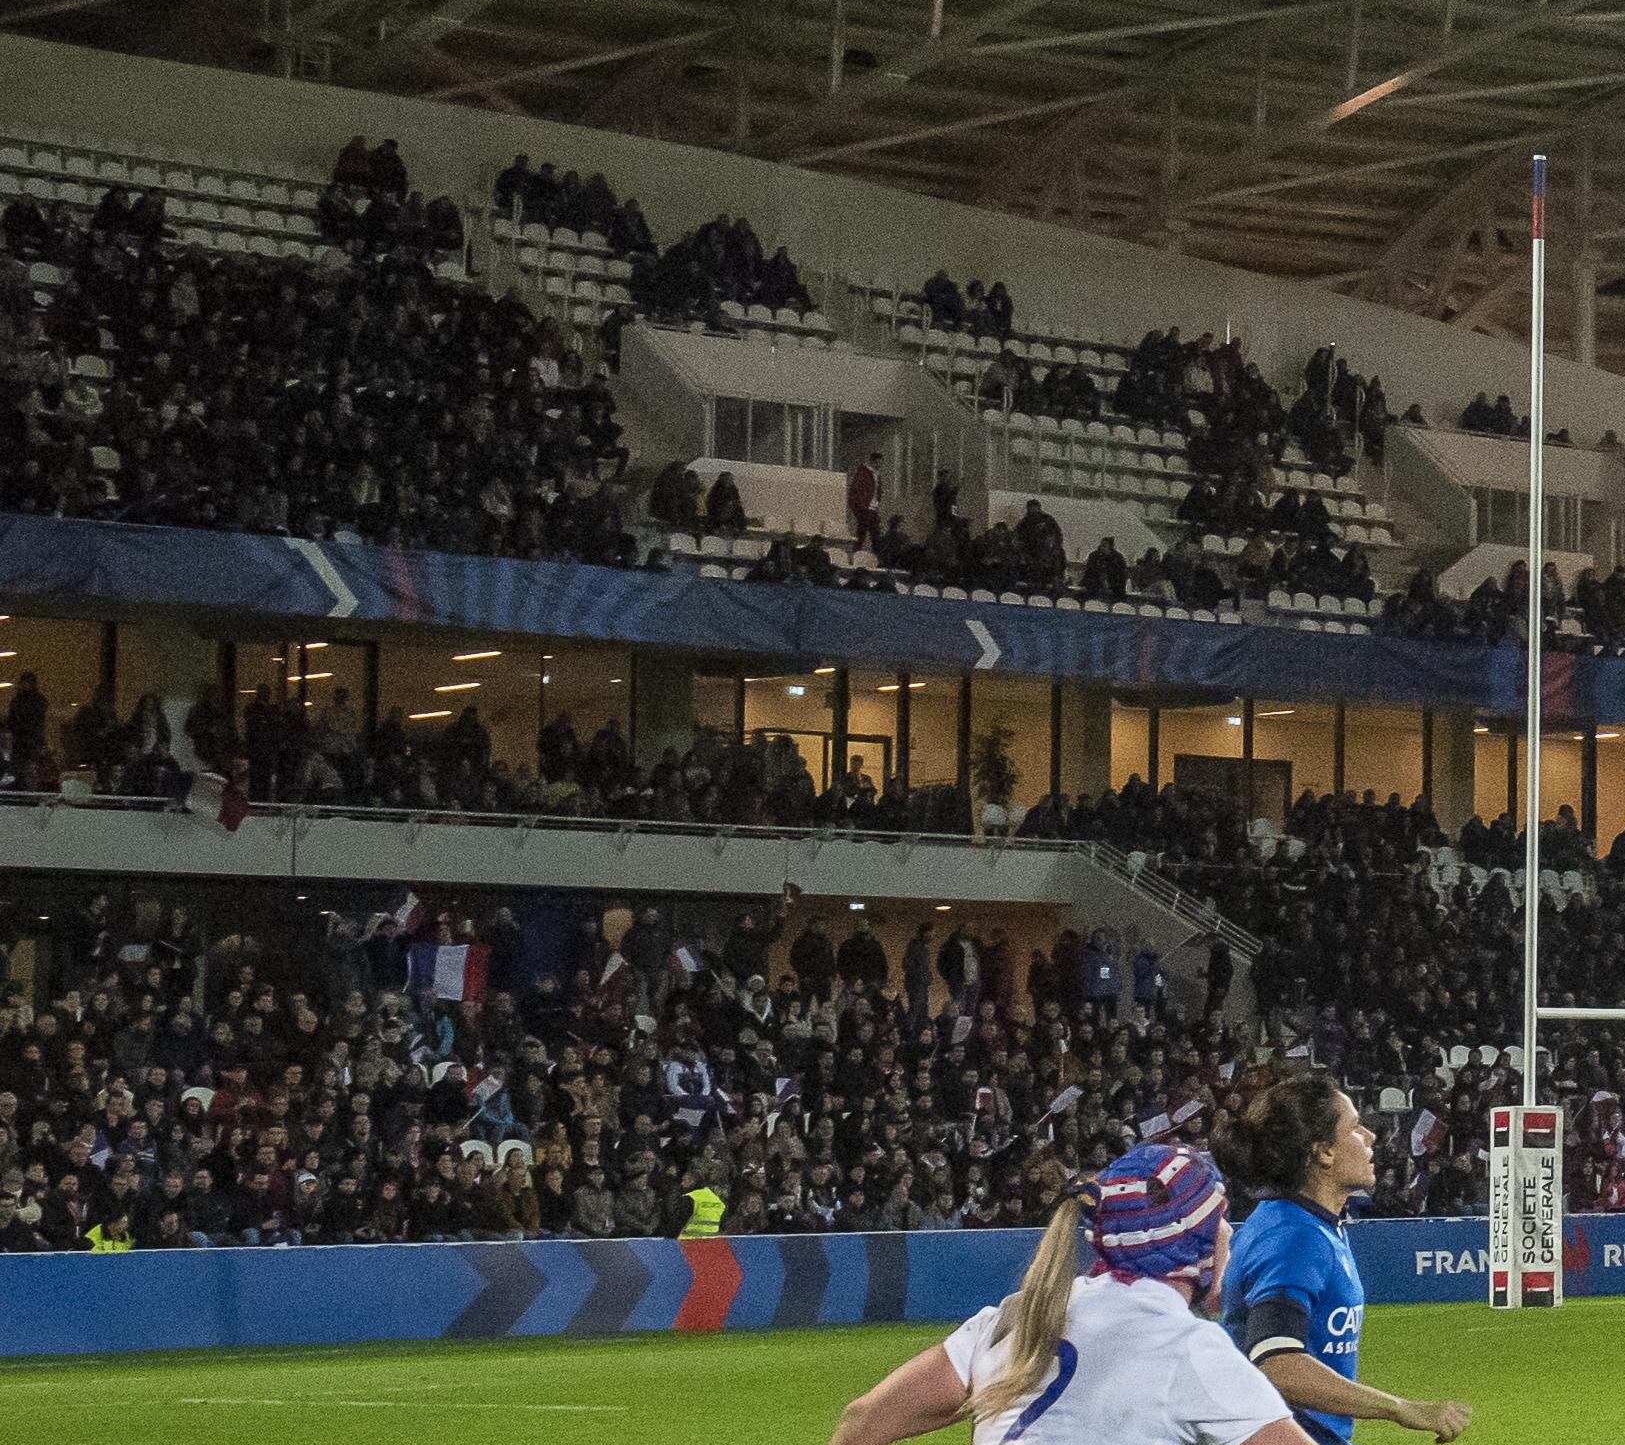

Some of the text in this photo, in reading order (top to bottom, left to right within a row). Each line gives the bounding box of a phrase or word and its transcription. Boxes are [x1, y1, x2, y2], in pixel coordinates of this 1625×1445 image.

[1493, 1176, 1501, 1263] SOCIETE
[1501, 1156, 1509, 1263] GENERALE
[1522, 1176, 1536, 1264] SOCIETE
[1541, 1156, 1554, 1264] GENERALE
[1415, 1249, 1490, 1275] FRAN
